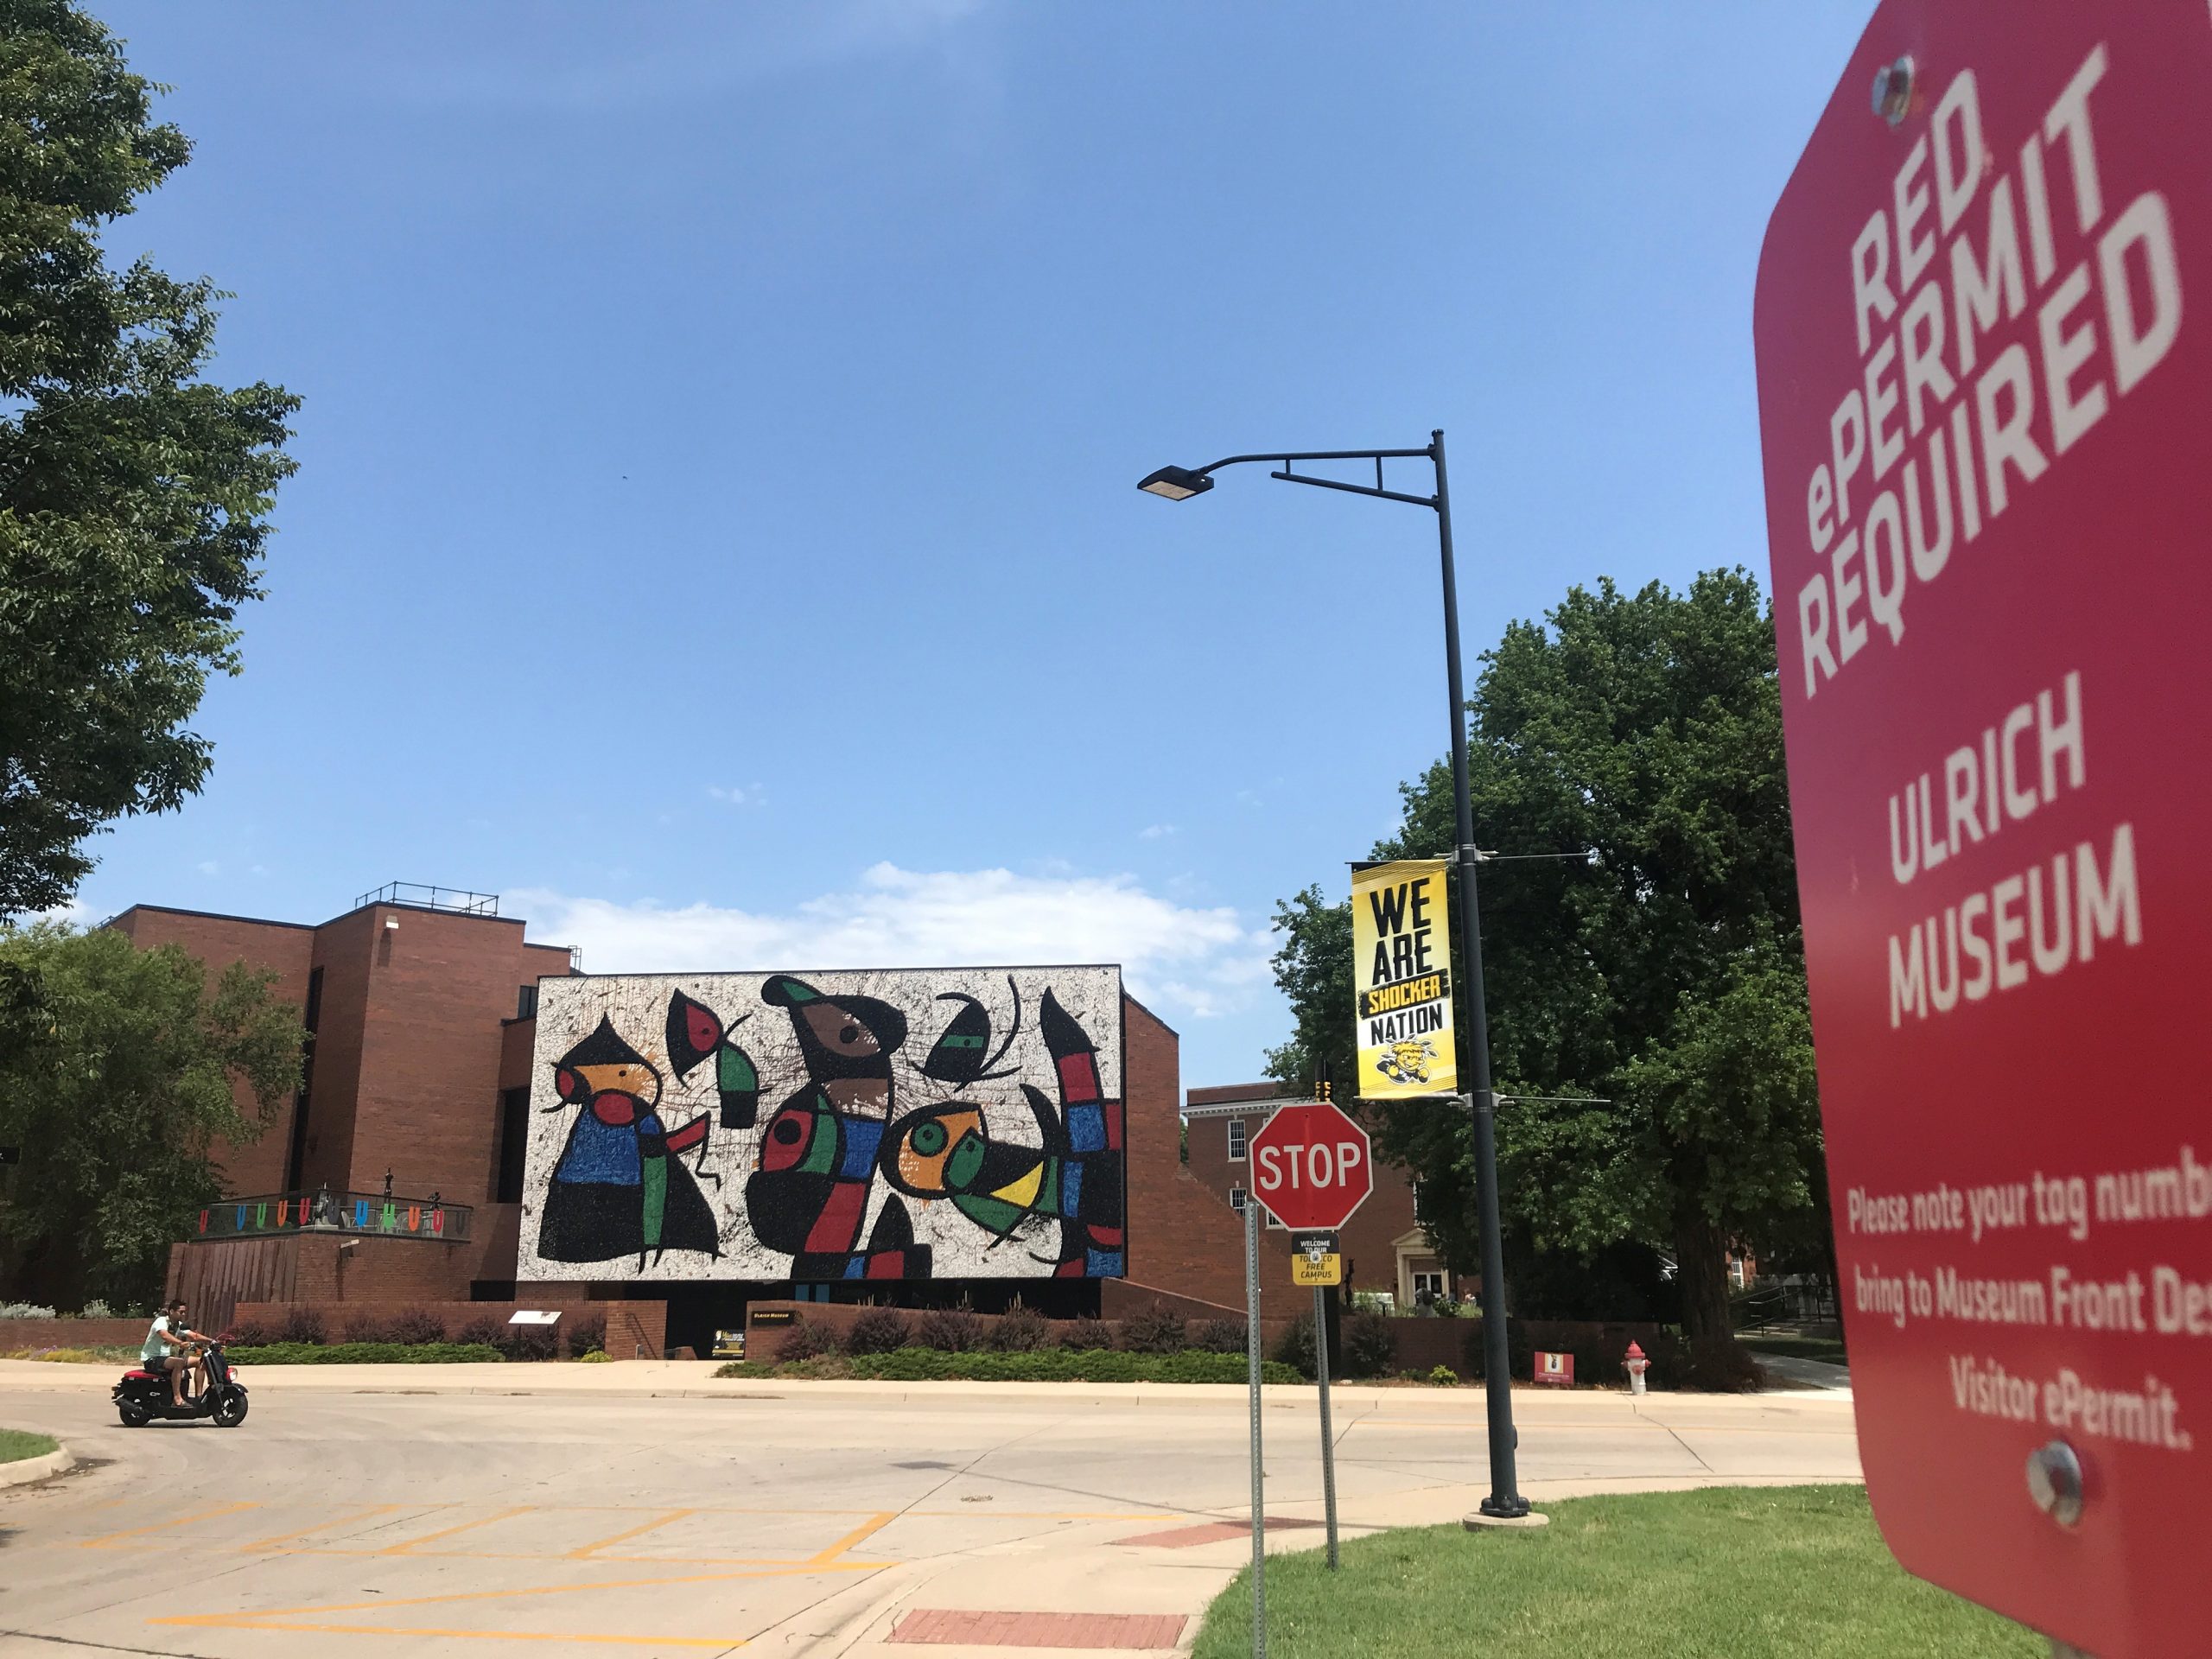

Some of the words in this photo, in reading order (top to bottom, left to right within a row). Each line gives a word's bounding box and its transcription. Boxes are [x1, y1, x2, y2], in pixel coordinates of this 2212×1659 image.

[1852, 69, 1985, 357] RED
[1807, 42, 2107, 554] ePERMIT
[1798, 191, 2183, 700] REQUIRED
[1889, 670, 2085, 885] ULRICH
[1370, 877, 1431, 938] WE
[1889, 823, 2141, 1028] MUSEUM
[1368, 975, 1440, 1014] SHOCKER
[1372, 928, 1433, 986] ARE
[1370, 1003, 1443, 1046] NATION
[1259, 1142, 1361, 1190] STOP
[1847, 1186, 1910, 1235] Please
[1912, 1183, 1964, 1231] note
[1967, 1183, 2028, 1243] your
[2031, 1172, 2088, 1241] tag
[2095, 1146, 2212, 1221] numb
[1854, 1263, 1906, 1328] bring
[1908, 1270, 1932, 1318] to
[1936, 1266, 2047, 1325] Museum
[2050, 1265, 2146, 1332] Front
[2152, 1265, 2212, 1336] De
[1949, 1354, 2038, 1423] Visitor
[2043, 1368, 2193, 1452] ePermit.
